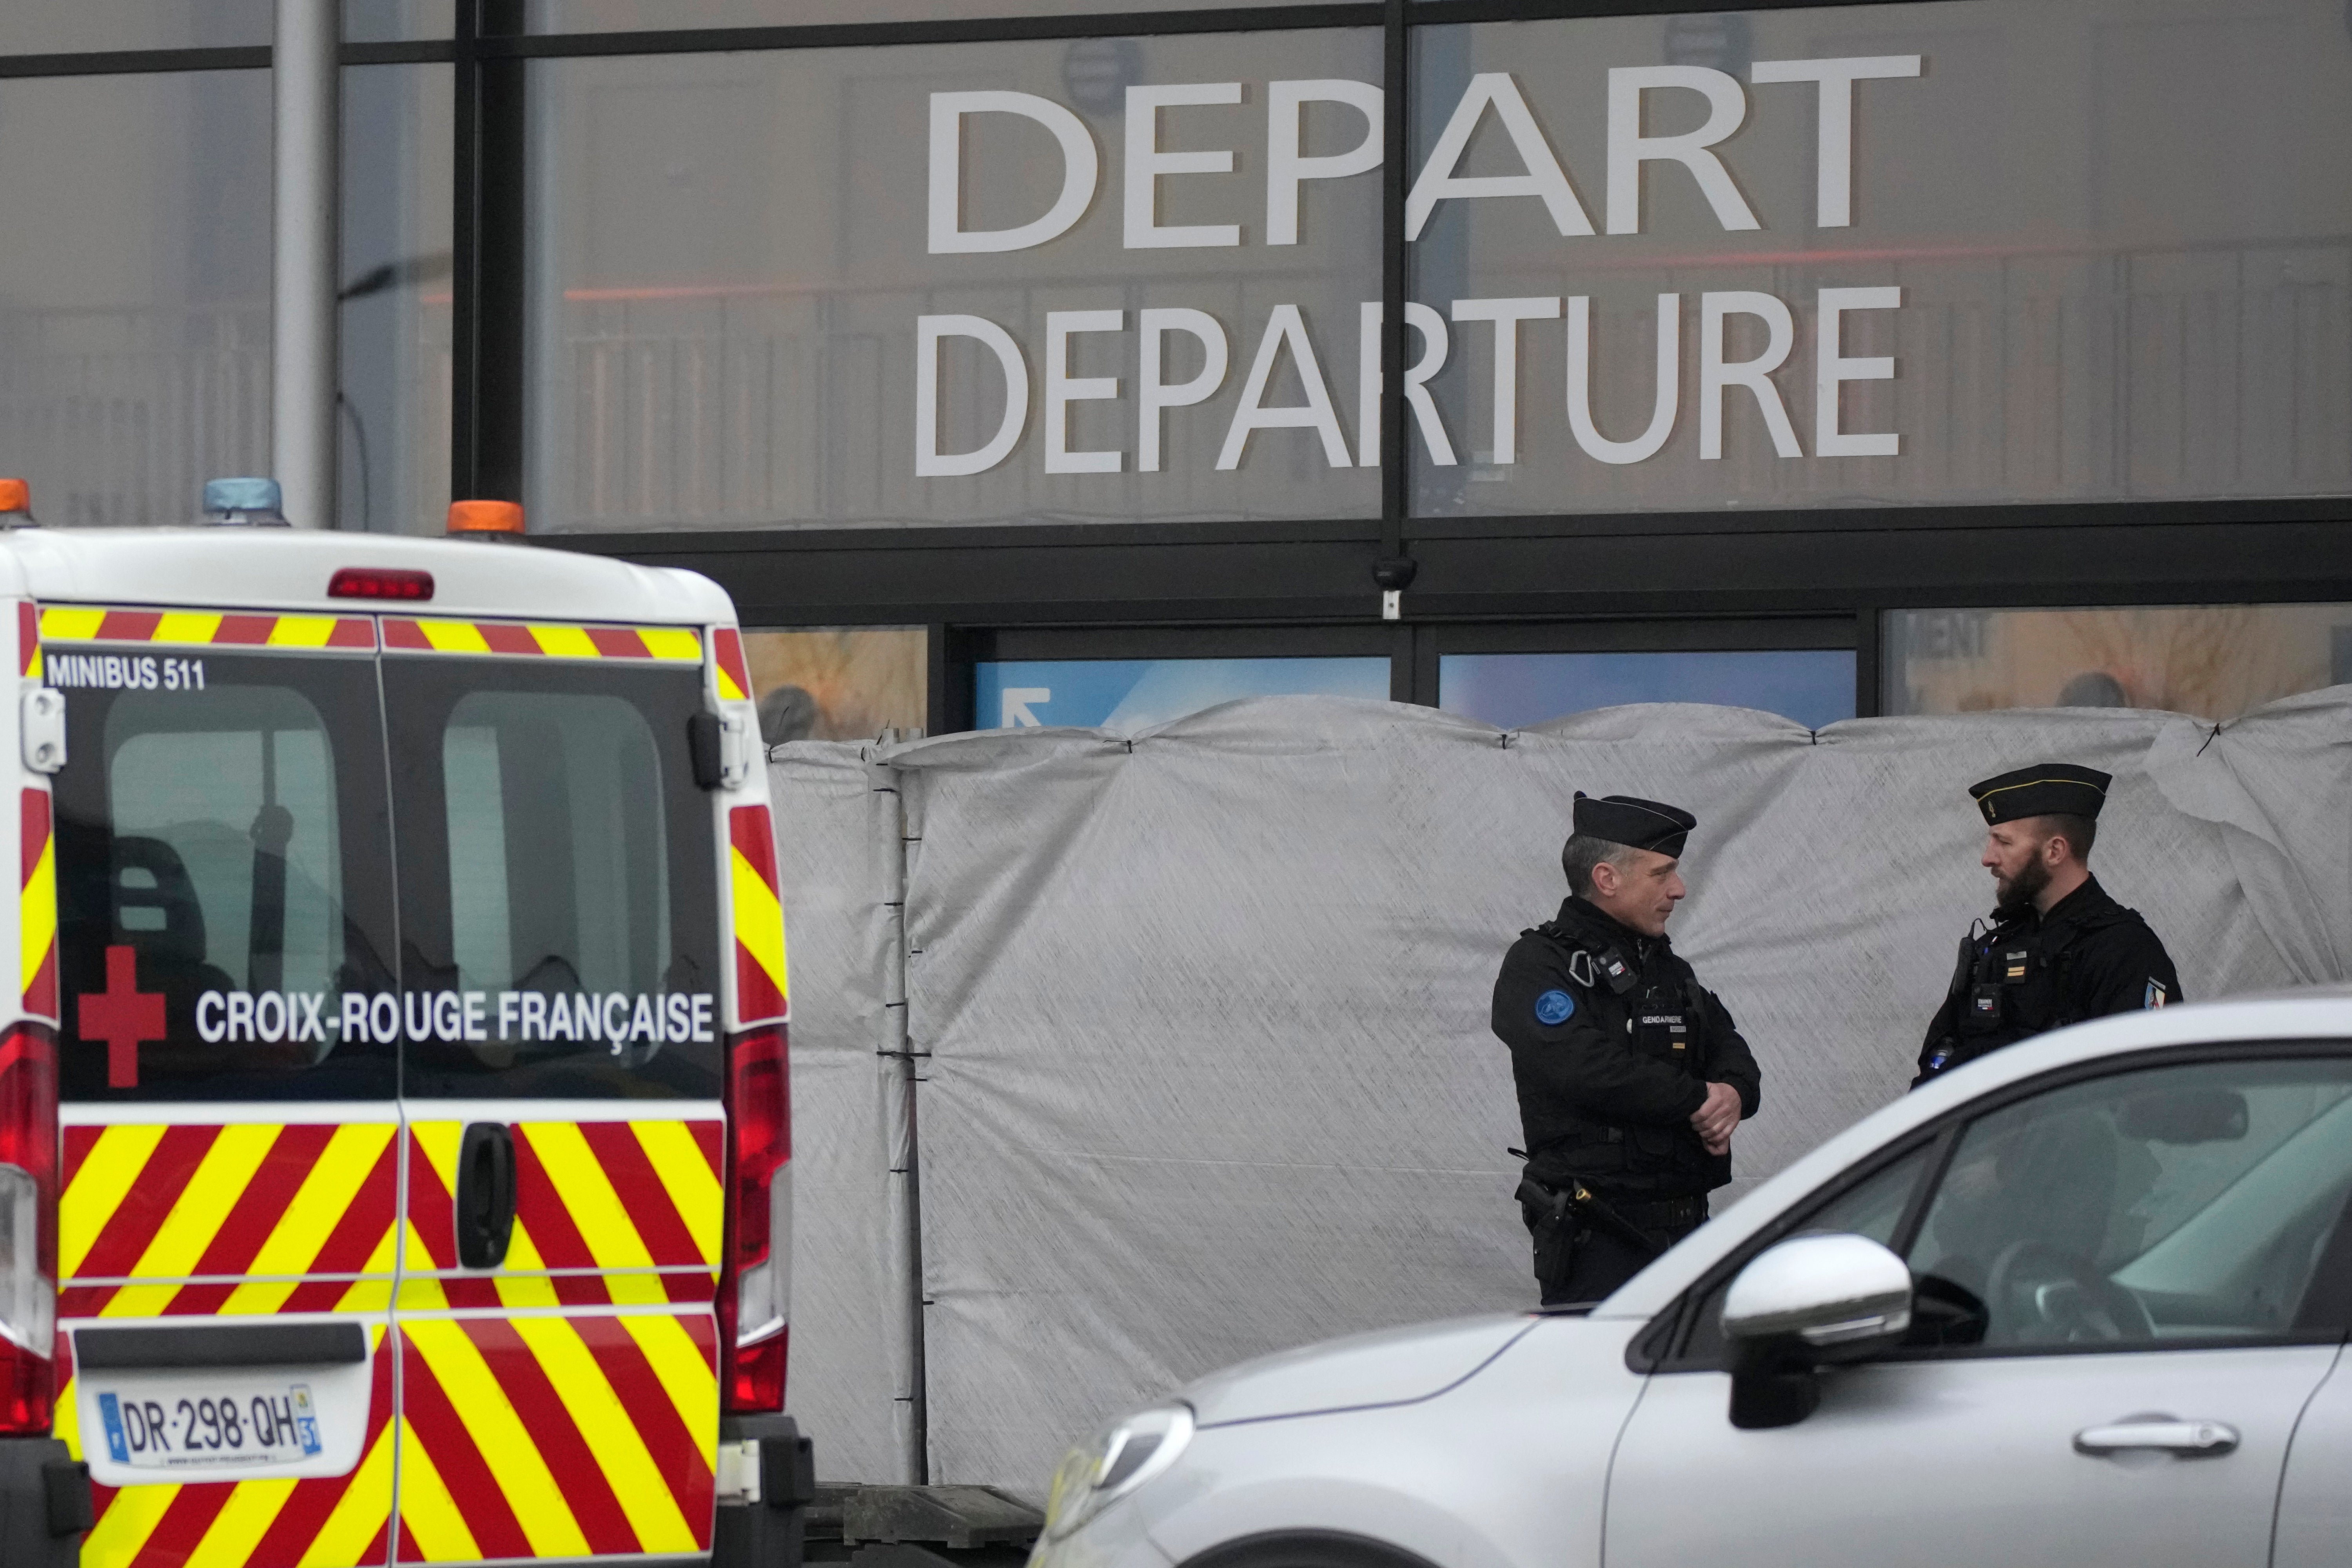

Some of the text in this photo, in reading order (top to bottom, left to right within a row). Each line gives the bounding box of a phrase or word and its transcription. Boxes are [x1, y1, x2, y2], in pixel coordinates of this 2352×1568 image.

[927, 56, 1922, 254] DEPART
[915, 286, 1900, 477] DEPARTURE
[47, 655, 205, 690] MINIBUS 511
[196, 991, 714, 1054] CROIX-ROUGE FRANÇAISE
